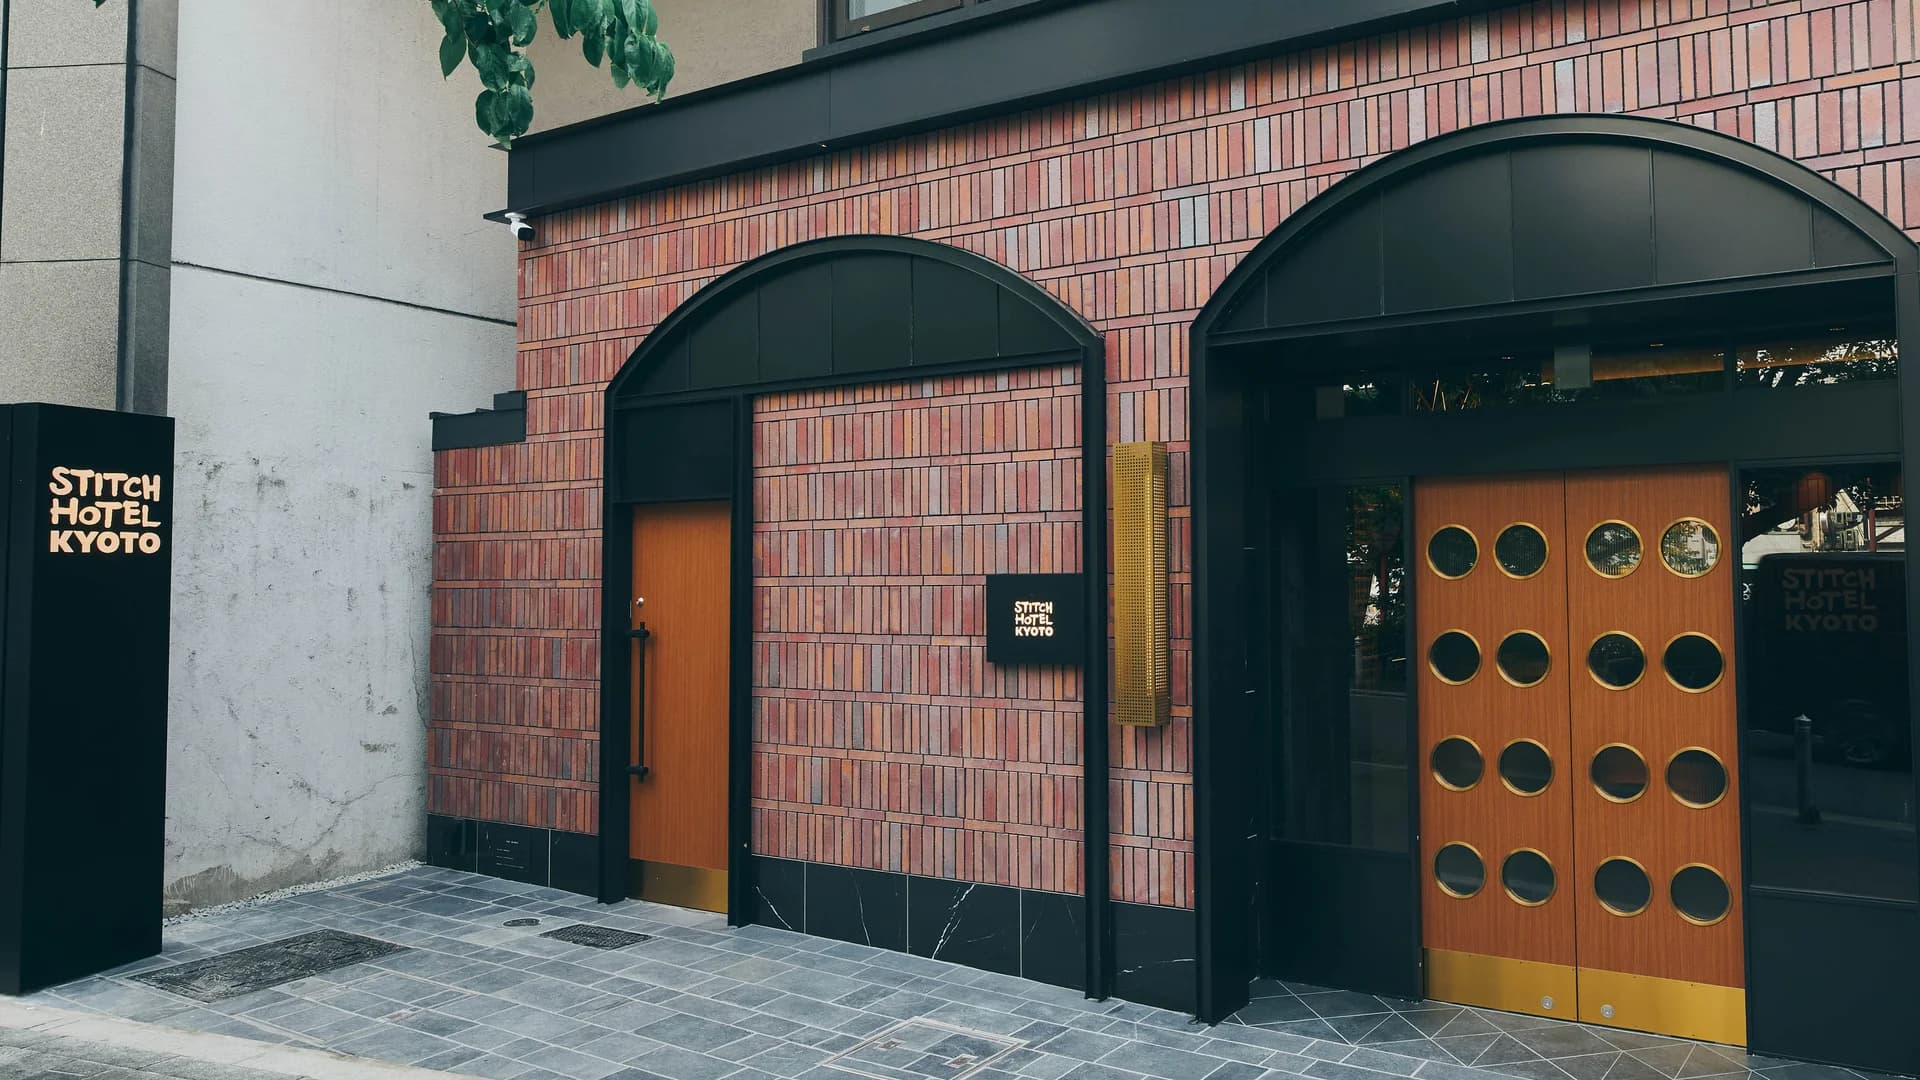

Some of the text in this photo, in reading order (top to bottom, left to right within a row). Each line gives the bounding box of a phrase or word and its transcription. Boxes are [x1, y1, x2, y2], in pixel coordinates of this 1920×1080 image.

[49, 466, 161, 502] STITCH
[49, 497, 161, 528] HOTEL
[49, 530, 161, 554] KYOTO
[1782, 568, 1876, 591] STITCH
[1014, 600, 1053, 614] STITCH
[1014, 613, 1054, 626] HOTEL
[1785, 614, 1879, 632] KYOTO
[1015, 626, 1054, 637] KYOTO
